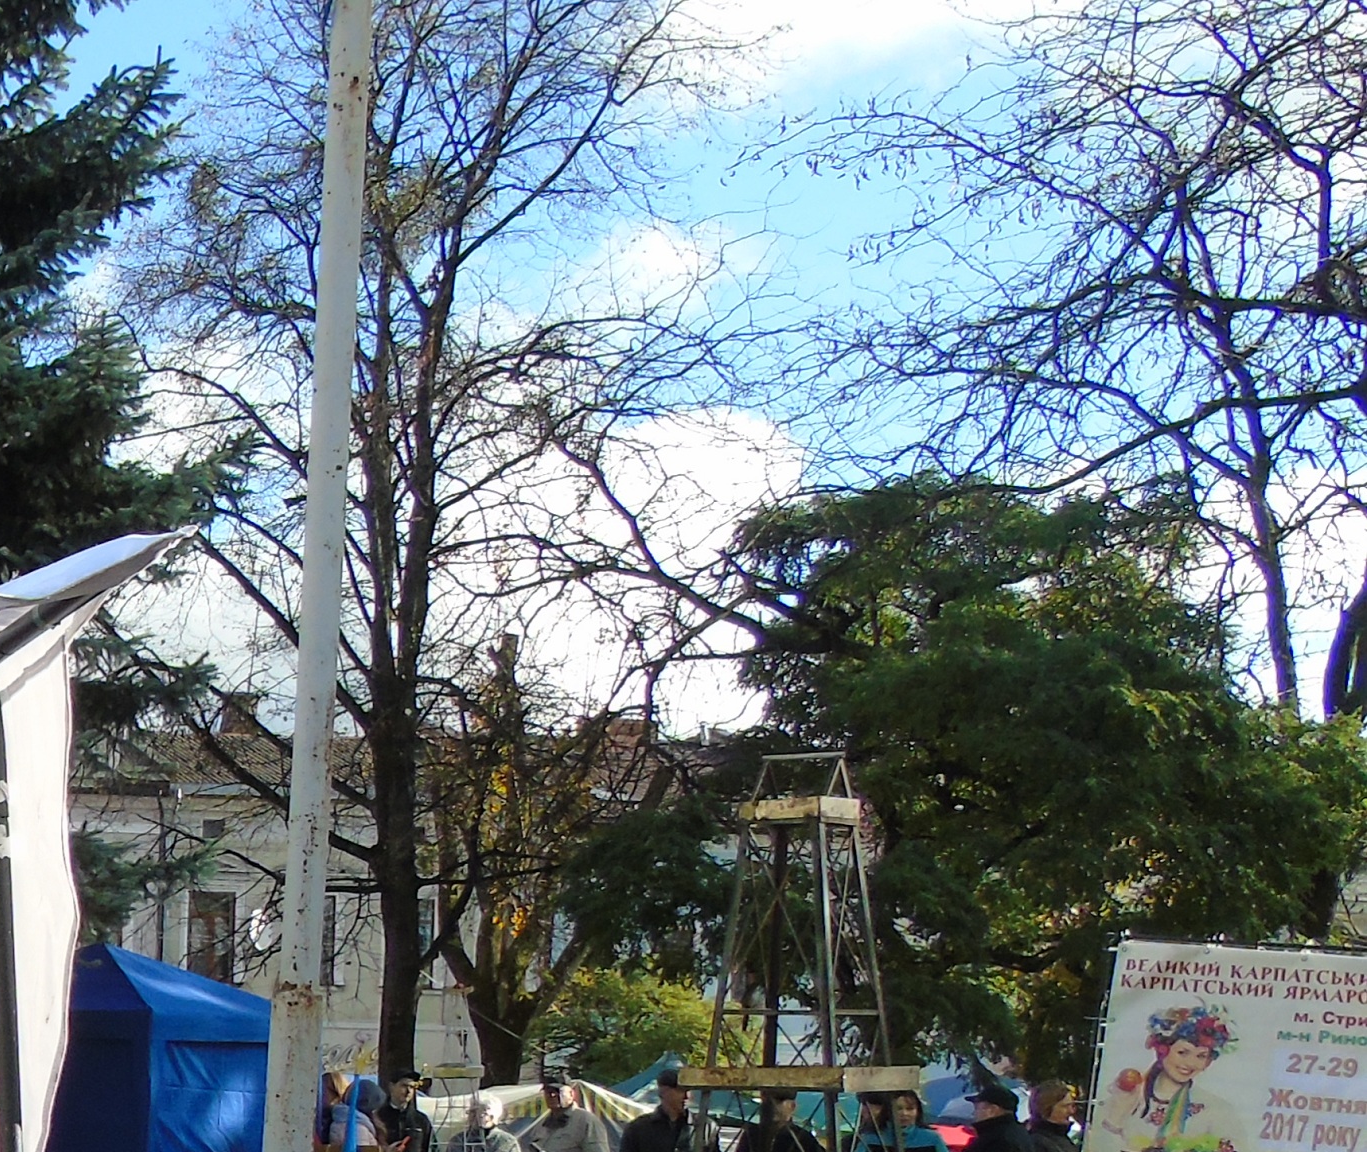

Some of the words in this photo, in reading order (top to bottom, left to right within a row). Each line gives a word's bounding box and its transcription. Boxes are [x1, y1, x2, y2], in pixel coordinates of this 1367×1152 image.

[1125, 959, 1220, 976] ВЕЛИКИЙ
[1120, 974, 1274, 998] КАРПАТСЬКИЙ
[1293, 1012, 1314, 1023] м.
[1285, 1053, 1358, 1078] 27-29
[1259, 1111, 1309, 1142] 2017
